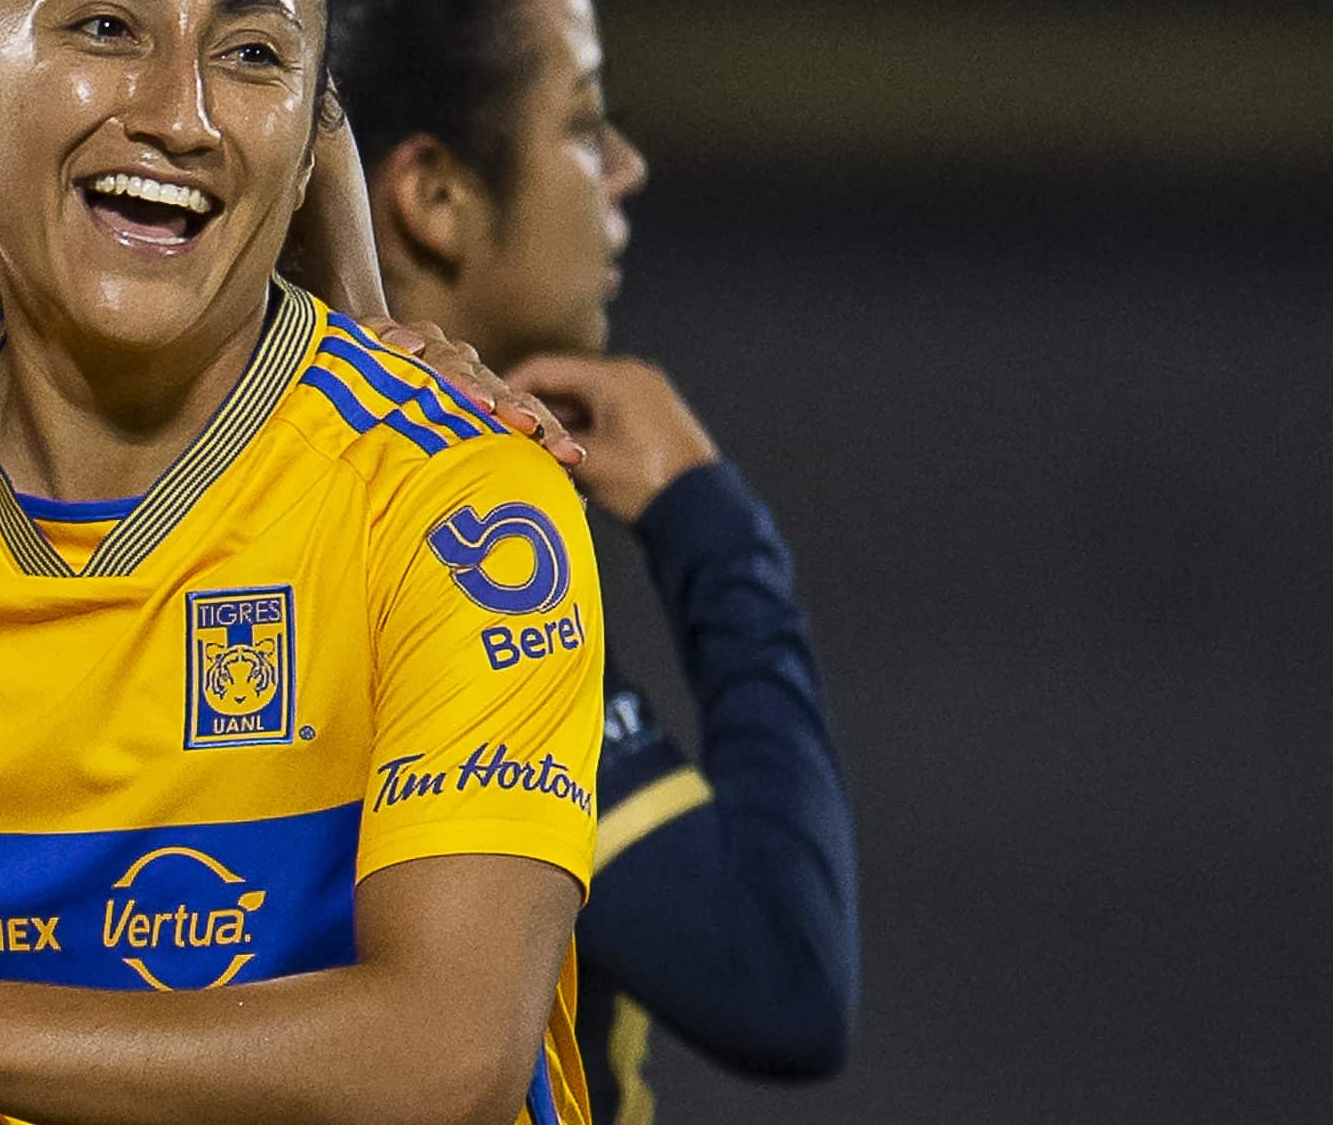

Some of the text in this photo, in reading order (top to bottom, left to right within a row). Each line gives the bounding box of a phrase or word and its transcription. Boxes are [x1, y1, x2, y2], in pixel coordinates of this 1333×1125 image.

[199, 599, 282, 627] TIGRES
[482, 603, 586, 671] Berel
[212, 714, 265, 735] UANL
[372, 752, 447, 813] Tim
